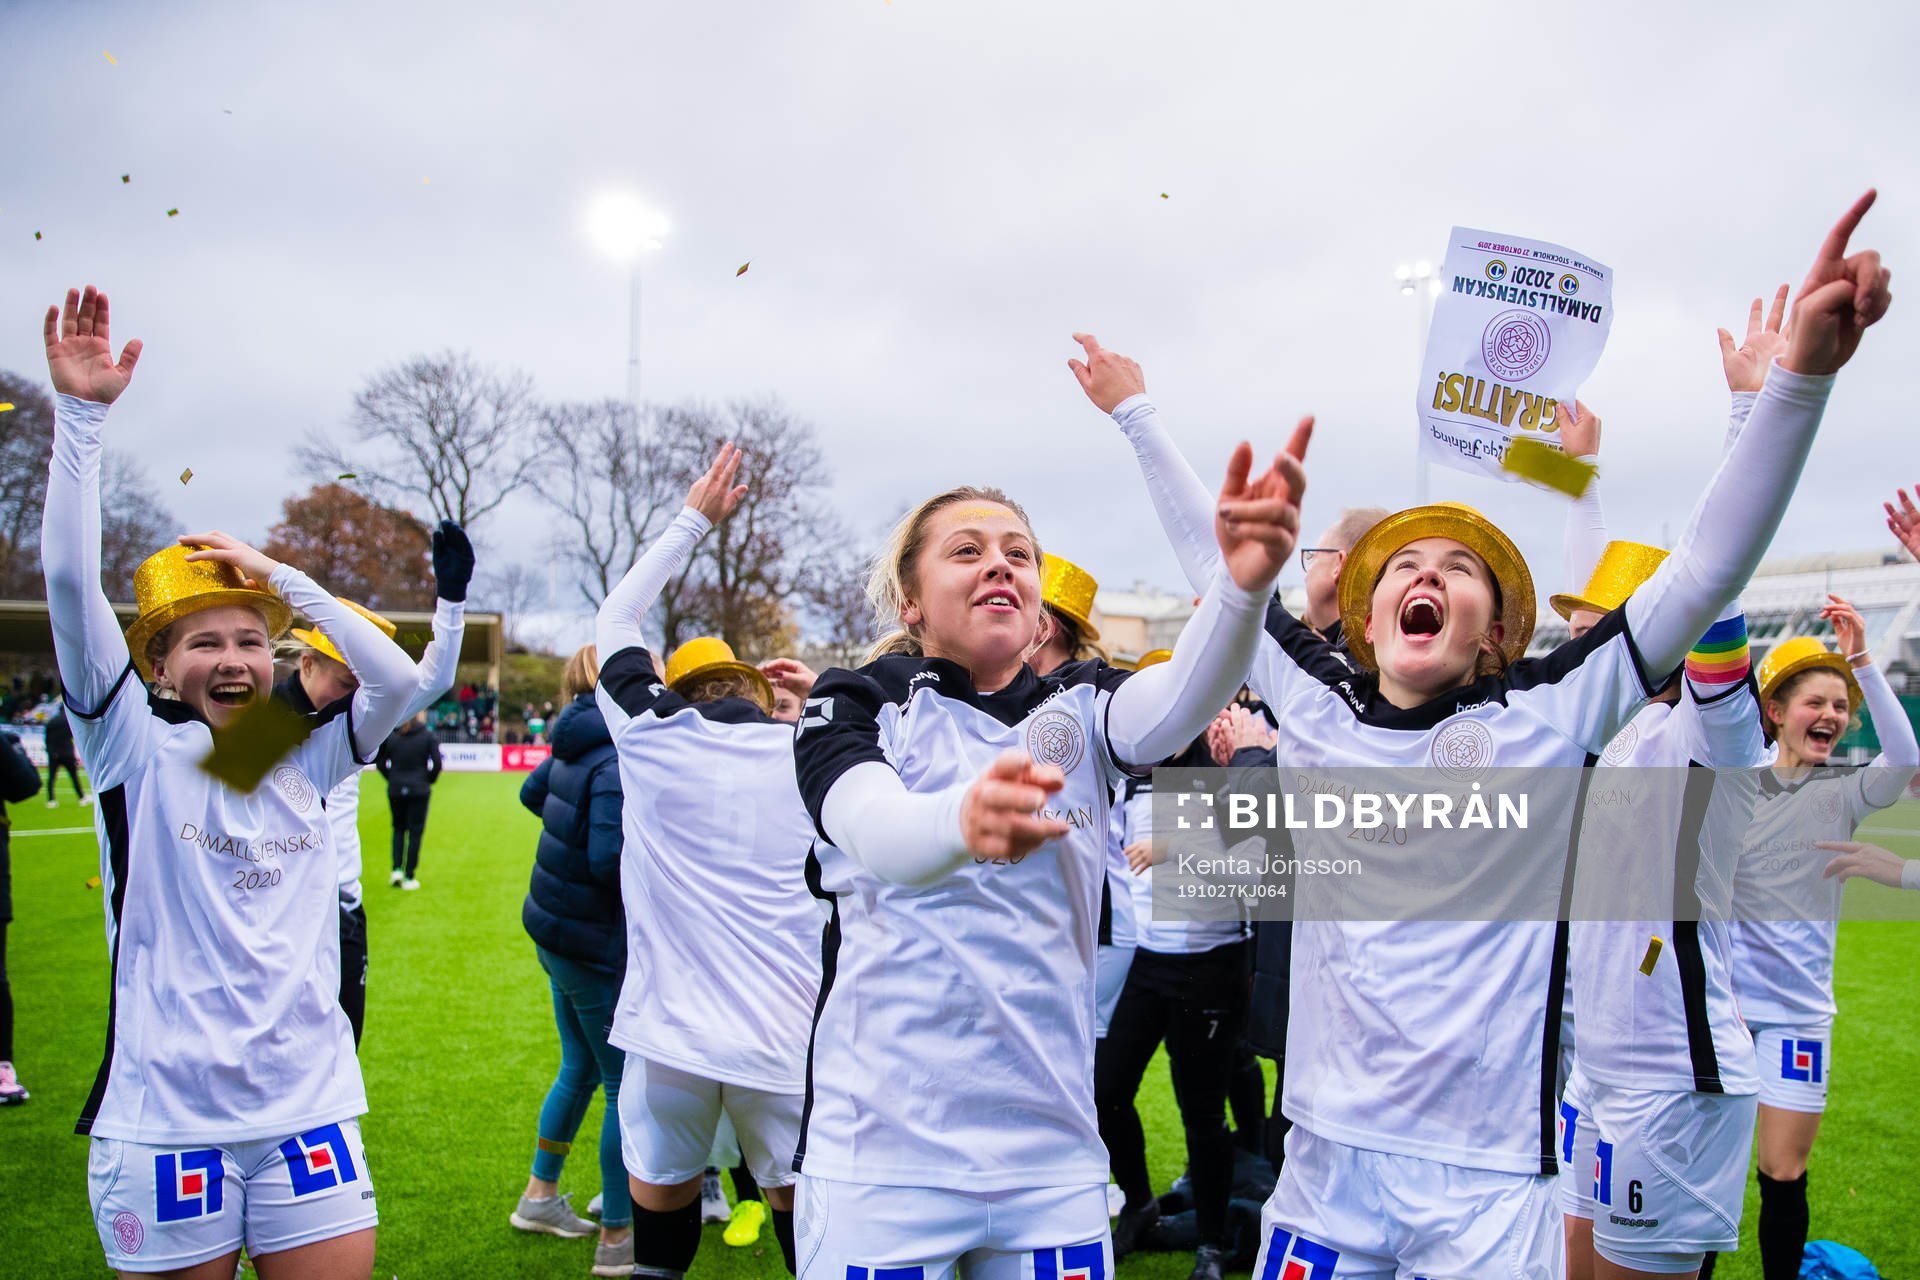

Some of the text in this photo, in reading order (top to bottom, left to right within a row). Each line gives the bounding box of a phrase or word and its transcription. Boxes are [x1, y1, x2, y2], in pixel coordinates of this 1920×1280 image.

[1477, 241, 1492, 249] 2019
[1492, 243, 1522, 255] OKTOBER
[1532, 250, 1570, 265] STOCKHOLM
[1510, 266, 1555, 290] 2020!
[1452, 275, 1602, 323] DAMALLSVENSKAN
[1486, 340, 1542, 377] UPPSALA FOTBOLL
[1432, 371, 1560, 433] GRATTIS!
[1052, 714, 1080, 741] FOTBOLL
[1461, 723, 1489, 745] FOTBOLL
[1761, 859, 1800, 871] 2020
[233, 868, 282, 890] 2020
[1208, 1019, 1219, 1039] 7
[1628, 1179, 1643, 1214] 6
[1610, 1215, 1659, 1228] STANNO
